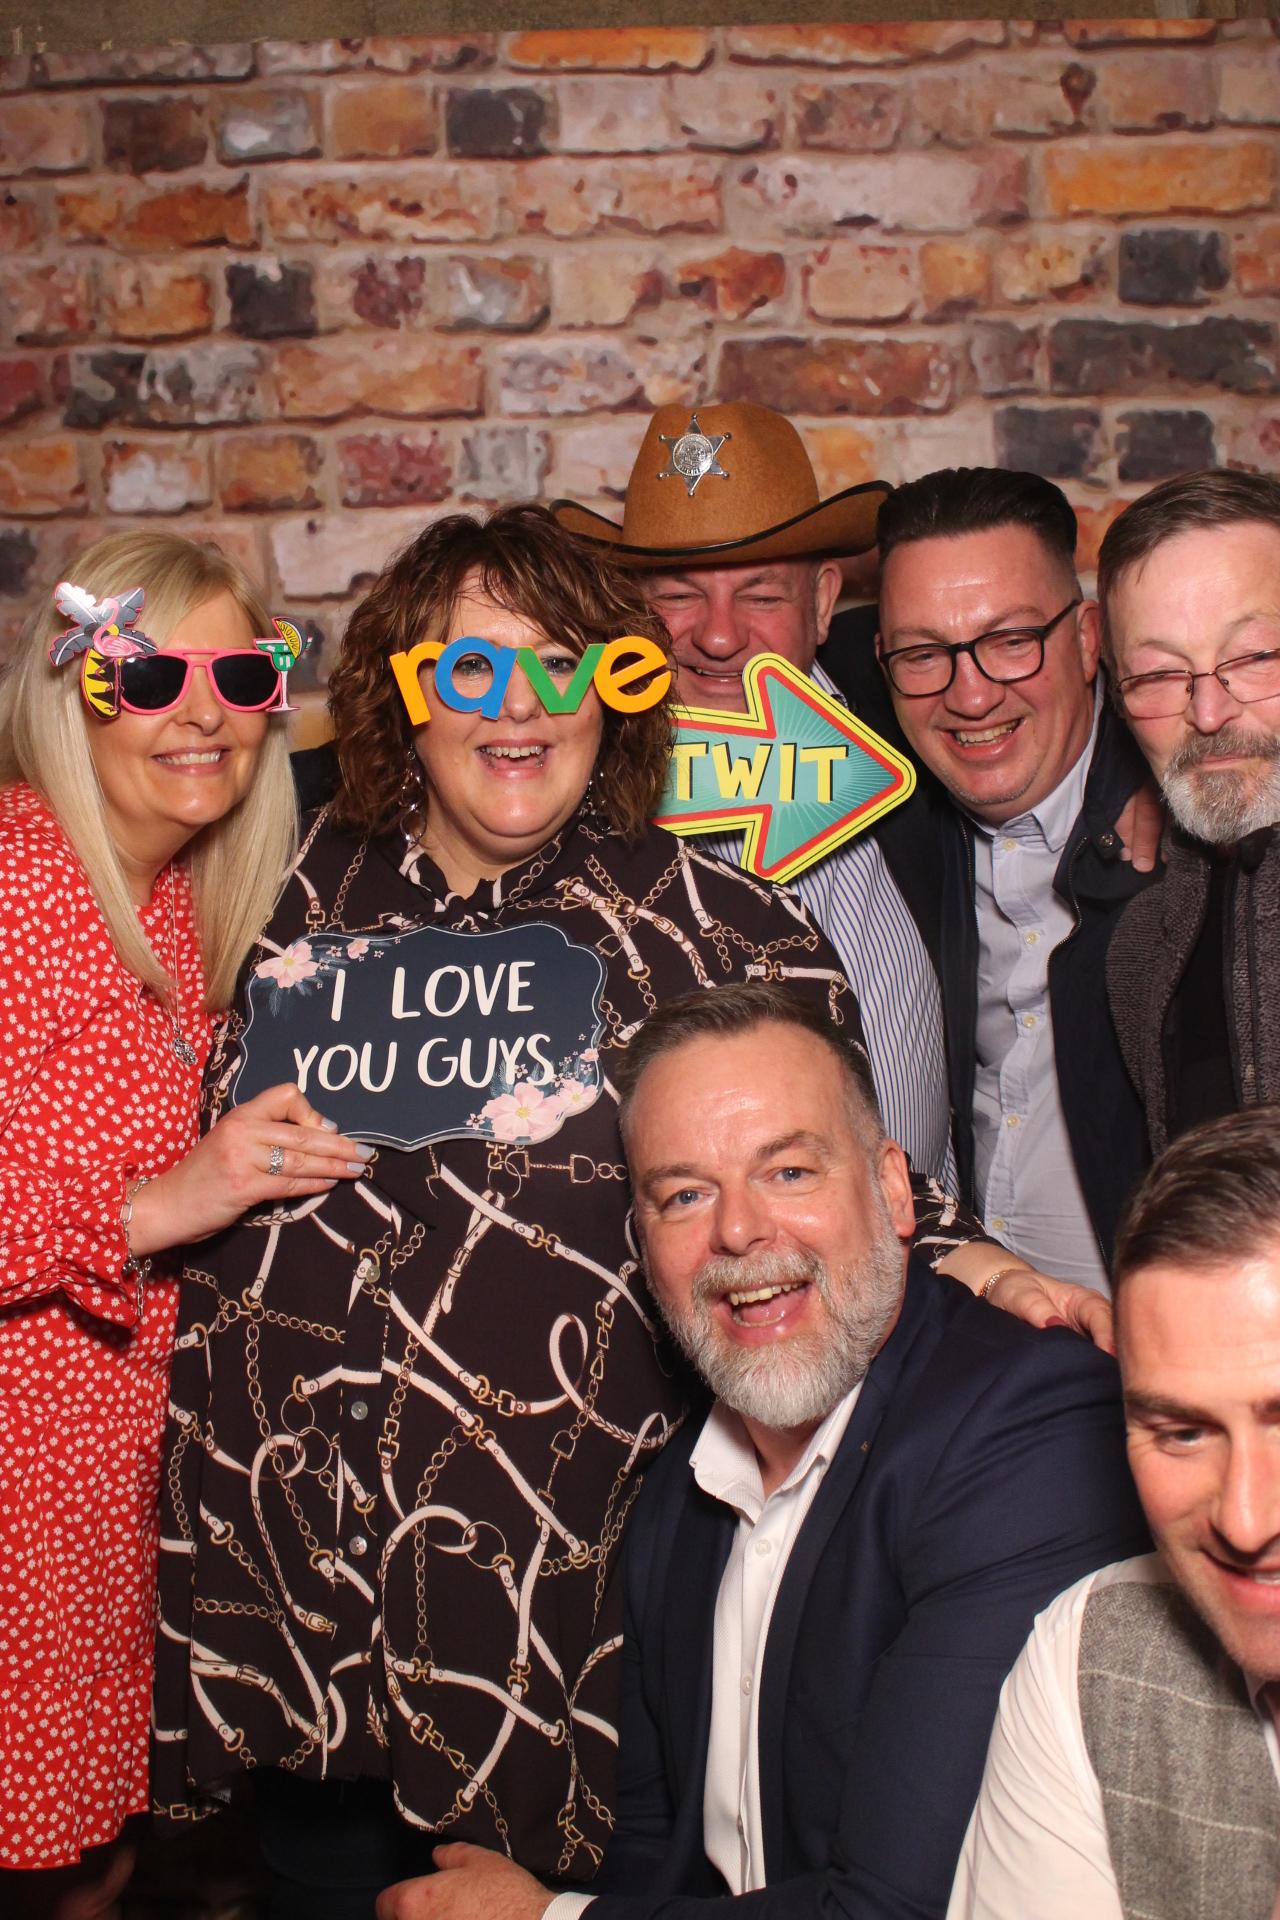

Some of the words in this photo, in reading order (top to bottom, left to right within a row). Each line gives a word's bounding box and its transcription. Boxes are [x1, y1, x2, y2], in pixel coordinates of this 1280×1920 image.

[389, 635, 673, 726] rave
[672, 741, 849, 805] TWIT
[331, 968, 346, 1022] I
[391, 961, 536, 1020] LOVE
[293, 1041, 398, 1094] YOU
[417, 1033, 555, 1088] GUYS
